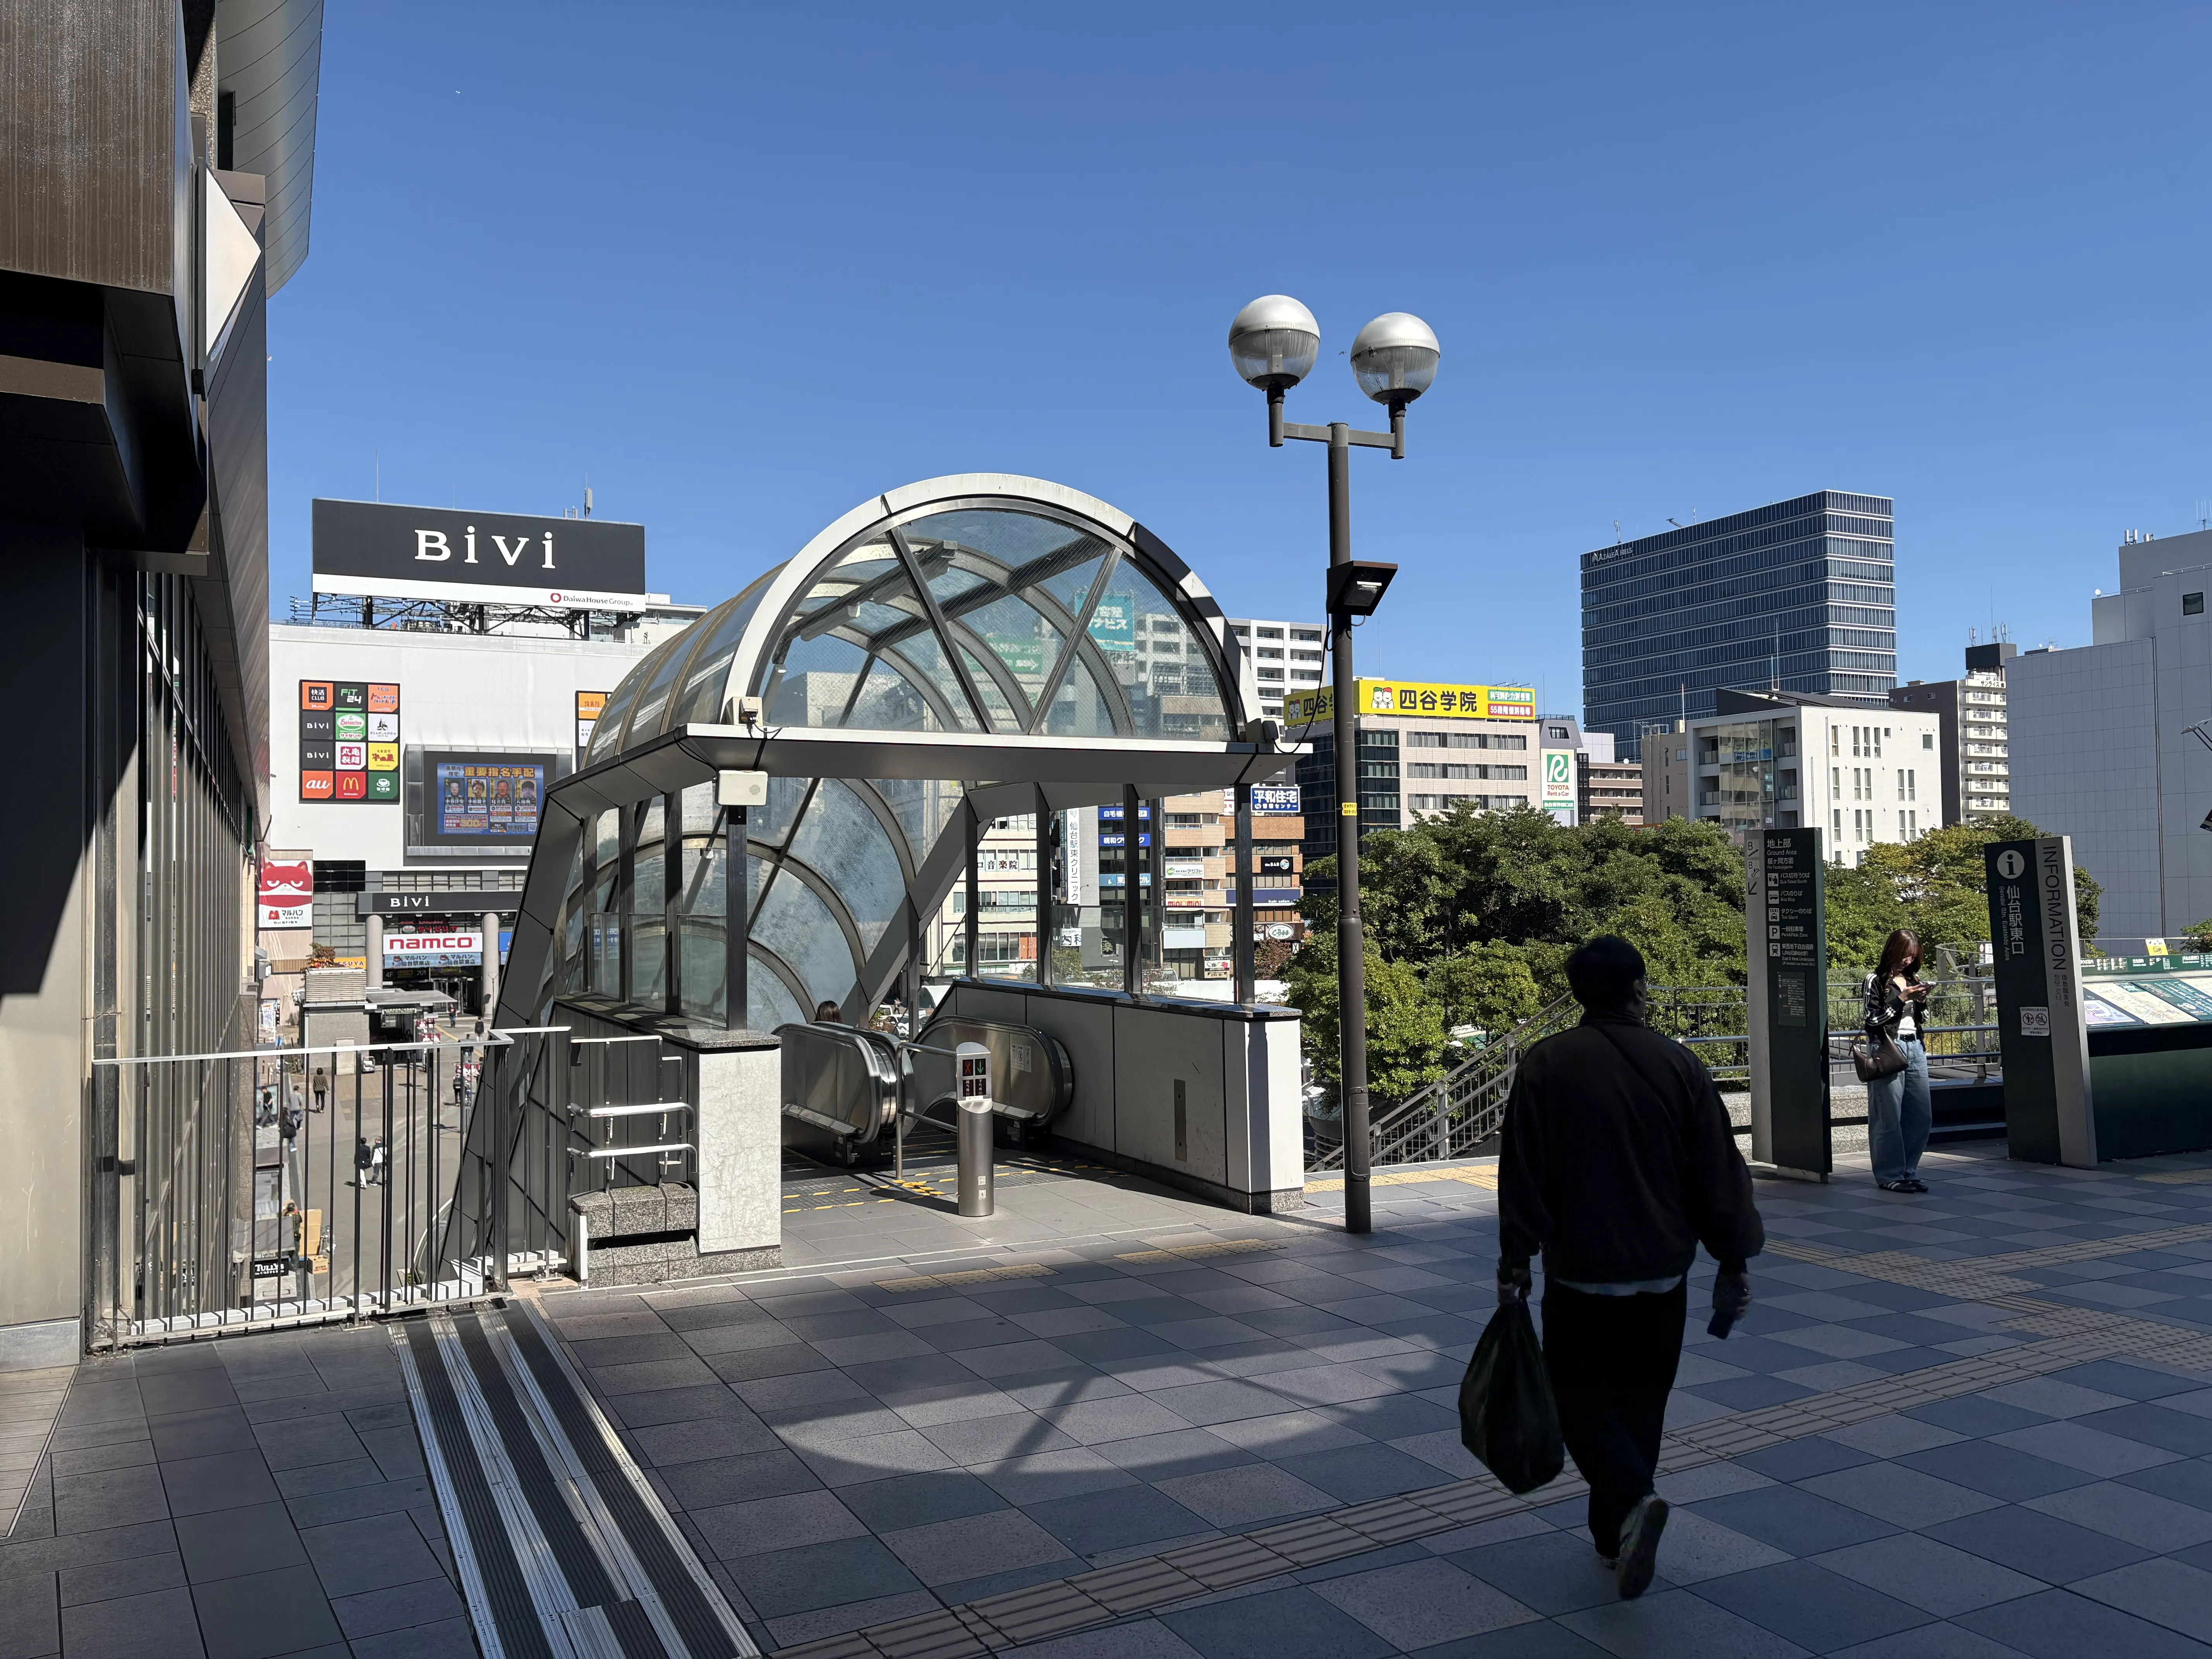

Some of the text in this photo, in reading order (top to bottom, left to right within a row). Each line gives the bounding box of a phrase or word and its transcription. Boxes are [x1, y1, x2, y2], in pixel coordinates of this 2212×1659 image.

[609, 598, 630, 607] Group
[347, 696, 361, 704] 24
[1400, 690, 1477, 712] 四谷学院
[342, 747, 360, 756] 丸亀
[464, 766, 535, 778] 重要指名手配
[306, 780, 330, 789] au
[1254, 790, 1297, 803] 平和住宅
[1748, 842, 1753, 850] B
[1767, 838, 1791, 848] 地上部
[1070, 822, 1078, 901] 仙台駅東クリニック
[2043, 846, 2066, 970] INFORMATION
[2007, 885, 2024, 955] 仙台駅東口
[417, 925, 458, 933] サイゼリヤ
[390, 937, 472, 949] namco
